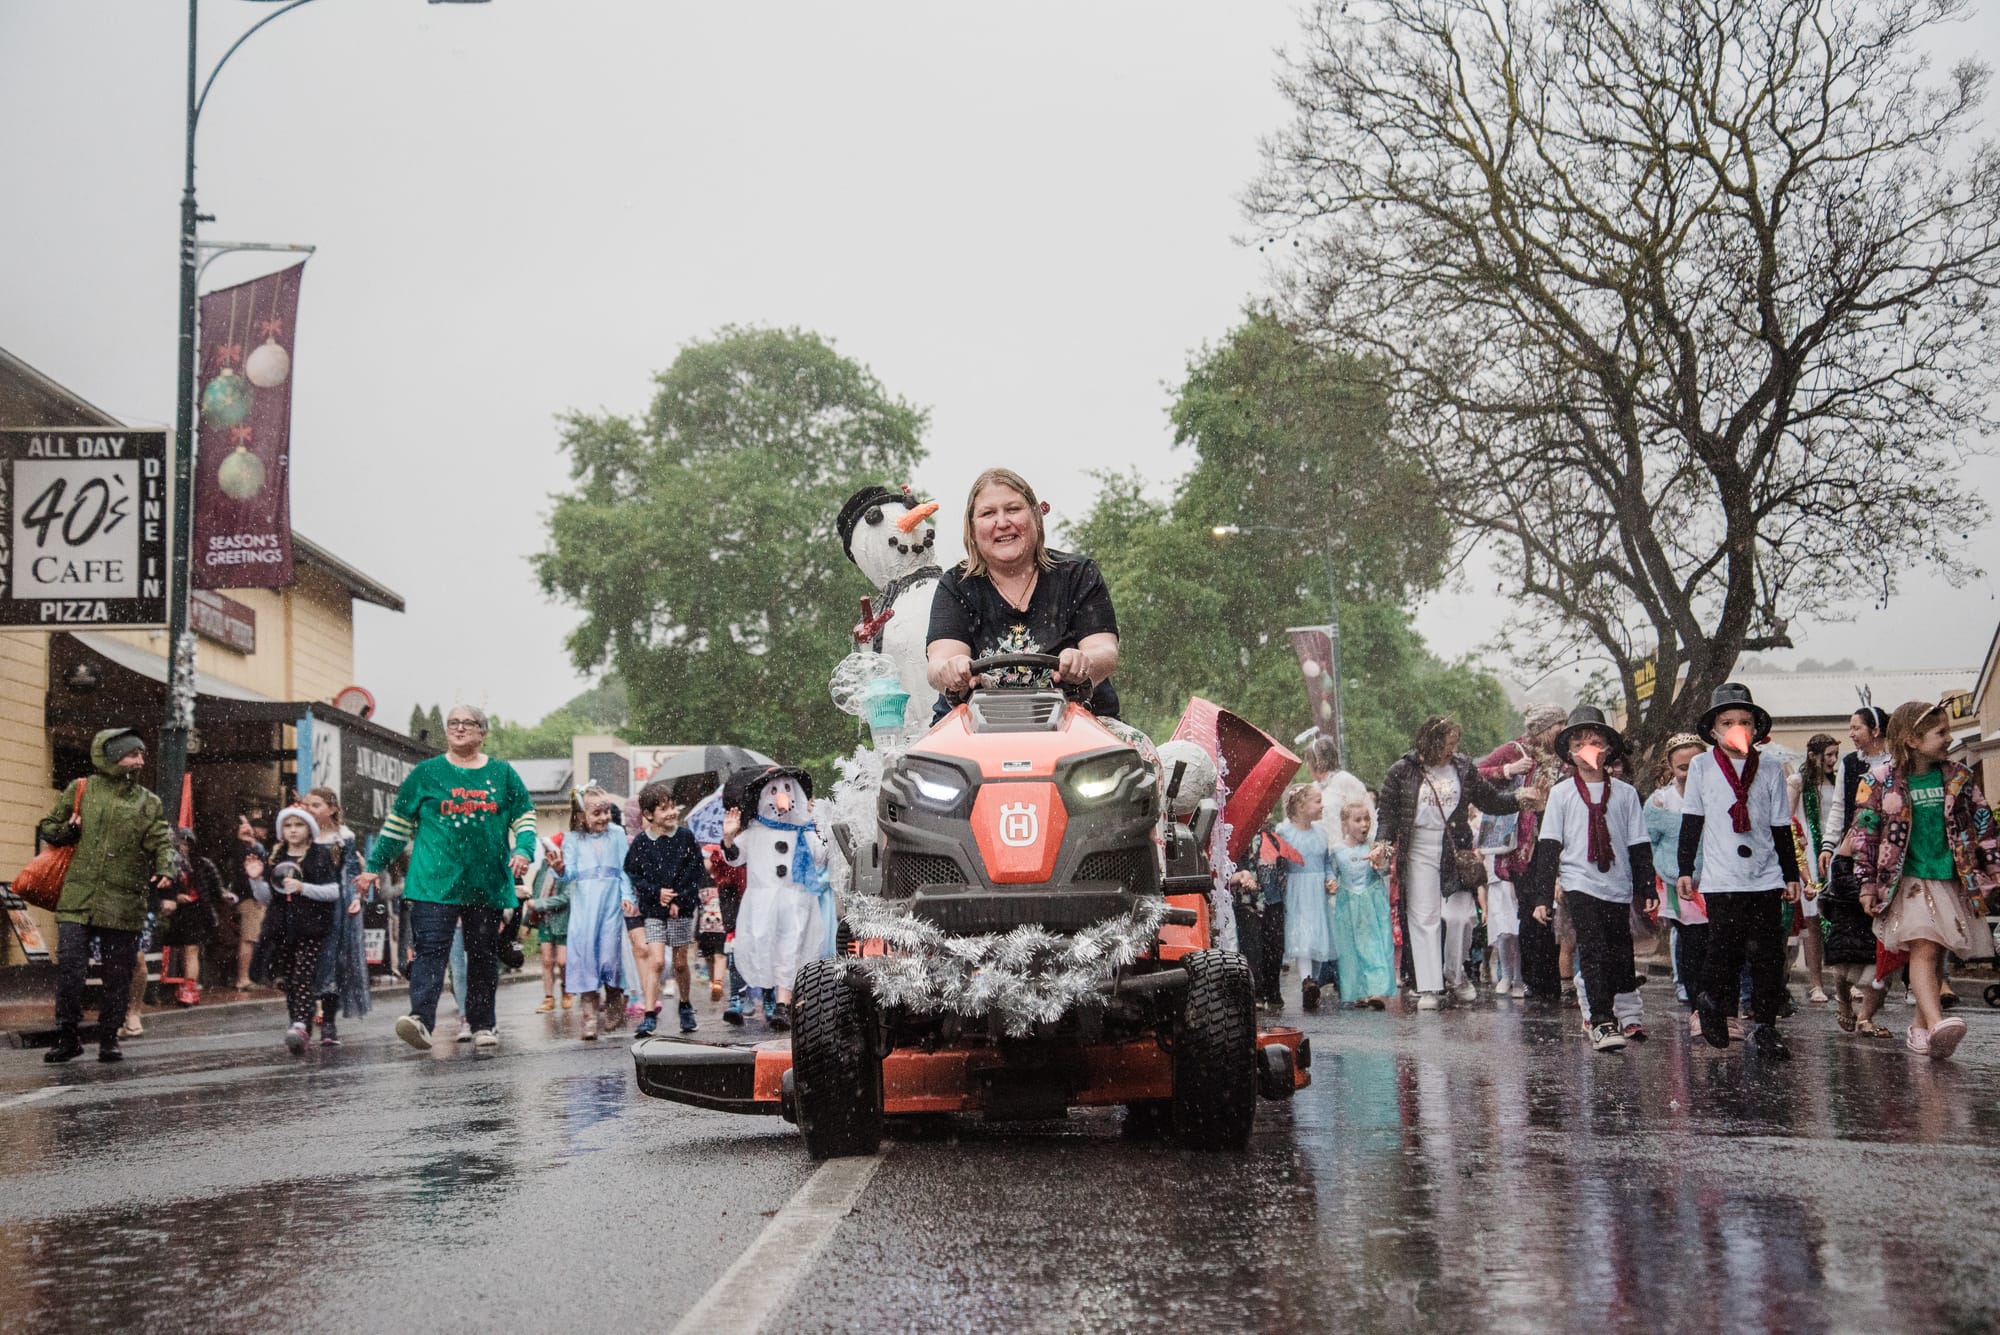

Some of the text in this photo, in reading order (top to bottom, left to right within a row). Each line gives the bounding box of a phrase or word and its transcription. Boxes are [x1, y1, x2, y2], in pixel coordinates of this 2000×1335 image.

[27, 437, 125, 457] ALL DAY
[143, 458, 160, 598] DINE IN
[209, 533, 279, 550] SEASON'S
[205, 549, 283, 565] GREETINGS
[40, 602, 108, 621] PIZZA
